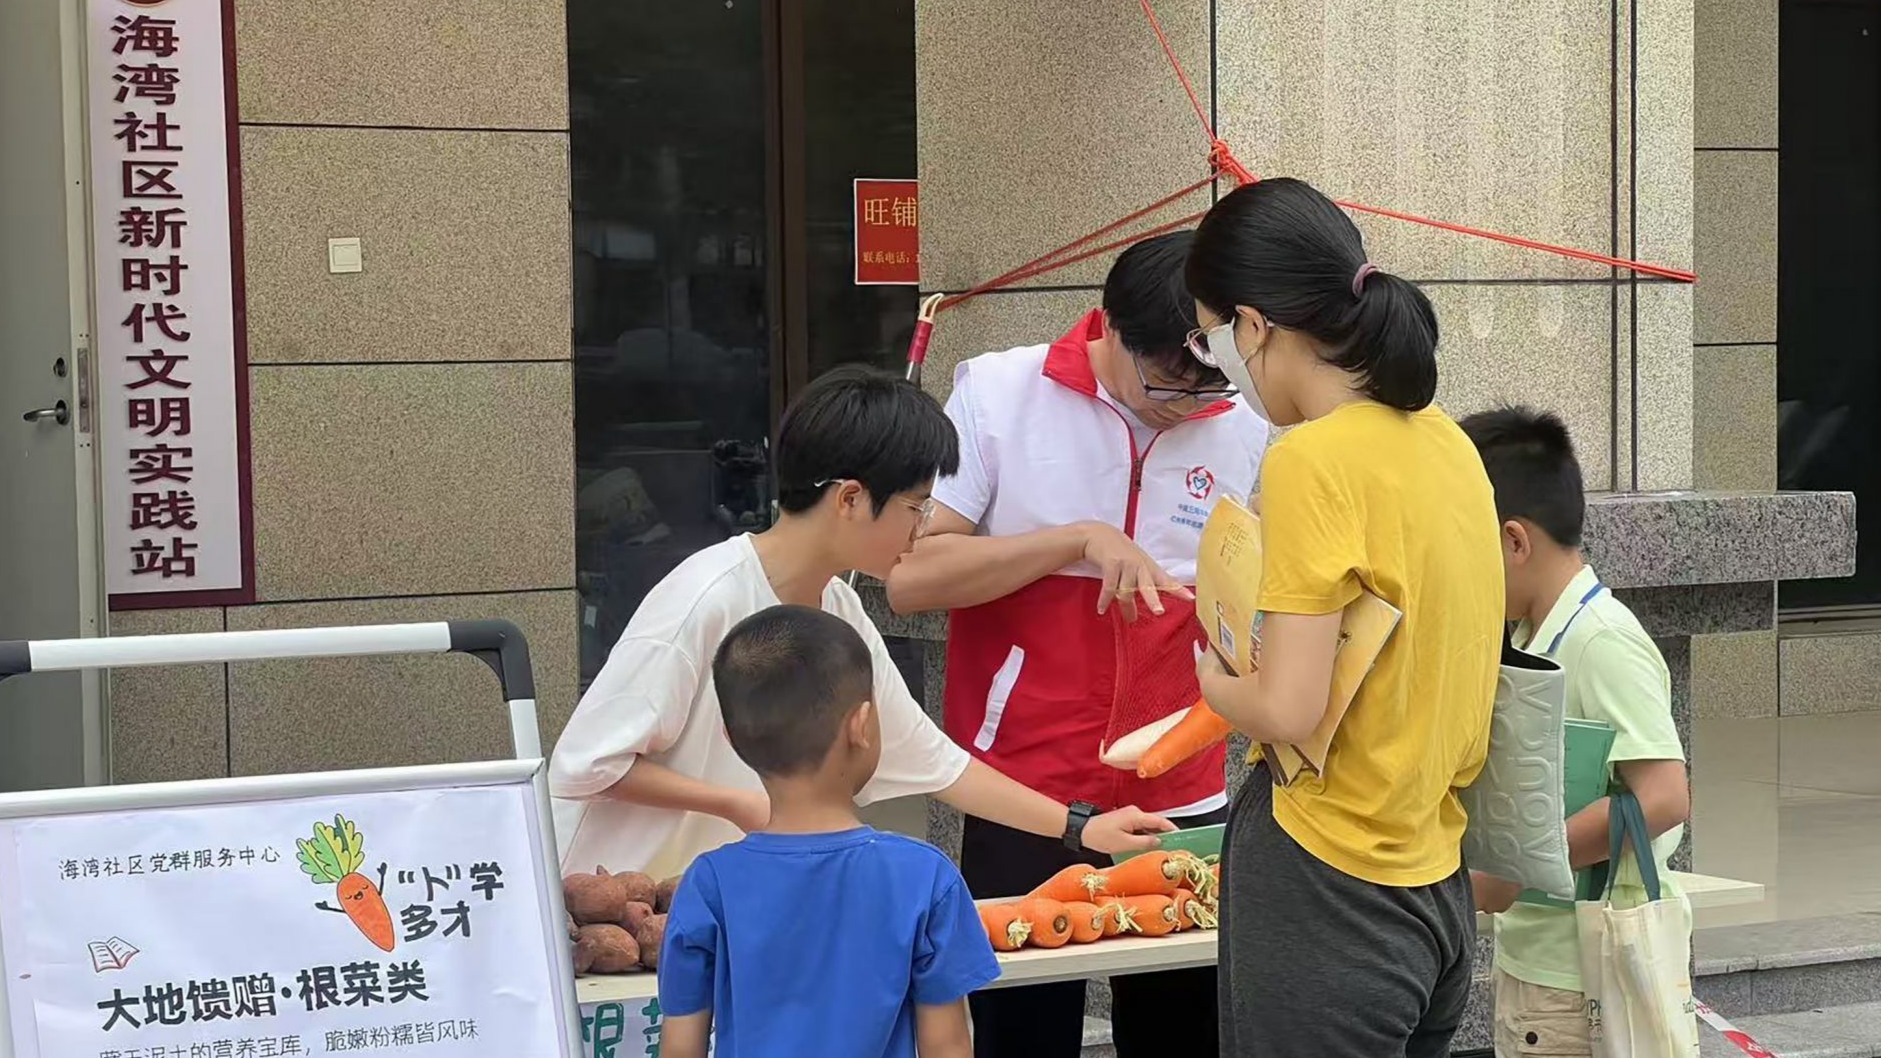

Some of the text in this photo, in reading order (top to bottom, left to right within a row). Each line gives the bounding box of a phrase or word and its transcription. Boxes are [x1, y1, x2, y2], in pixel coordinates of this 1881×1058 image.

[863, 196, 917, 227] 旺铺
[110, 14, 198, 578] 海湾社区新时代文明实践站
[58, 844, 281, 880] 海湾社区党群服务中心
[399, 899, 471, 942] 多才
[97, 959, 430, 1031] 大地馈赠·根菜类
